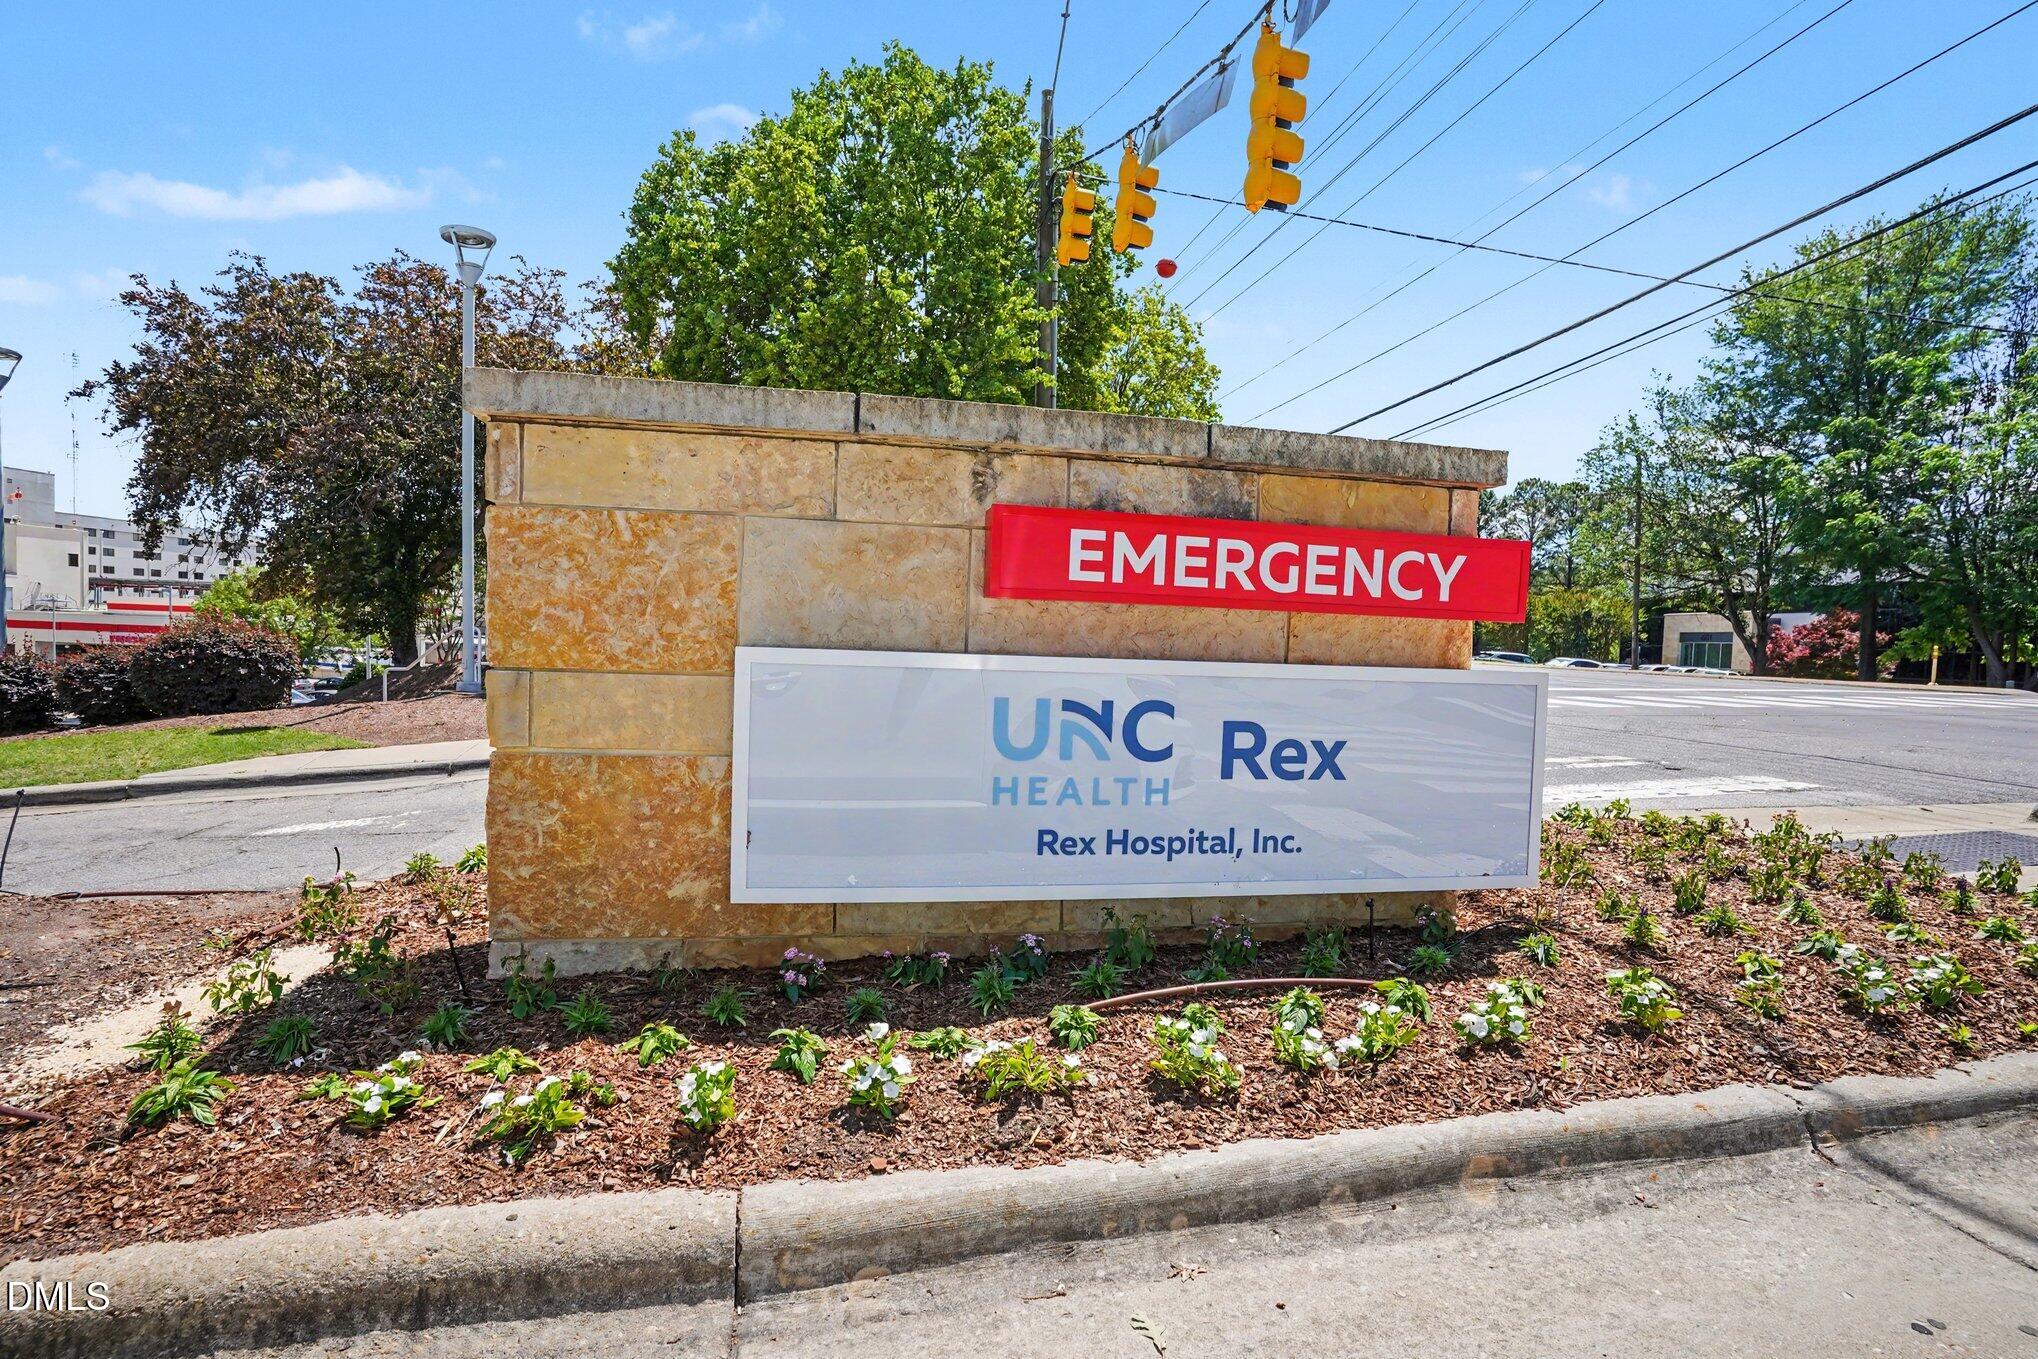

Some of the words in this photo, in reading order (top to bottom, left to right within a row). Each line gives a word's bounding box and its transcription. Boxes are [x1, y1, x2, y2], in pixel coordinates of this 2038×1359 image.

[1068, 529, 1467, 602] EMERGENCY
[992, 698, 1176, 764] UNC
[1220, 720, 1347, 782] Rex
[991, 776, 1171, 807] HEALTH
[1036, 828, 1097, 857] Rex
[1106, 828, 1244, 862] Hospital,
[1252, 828, 1304, 855] Inc.
